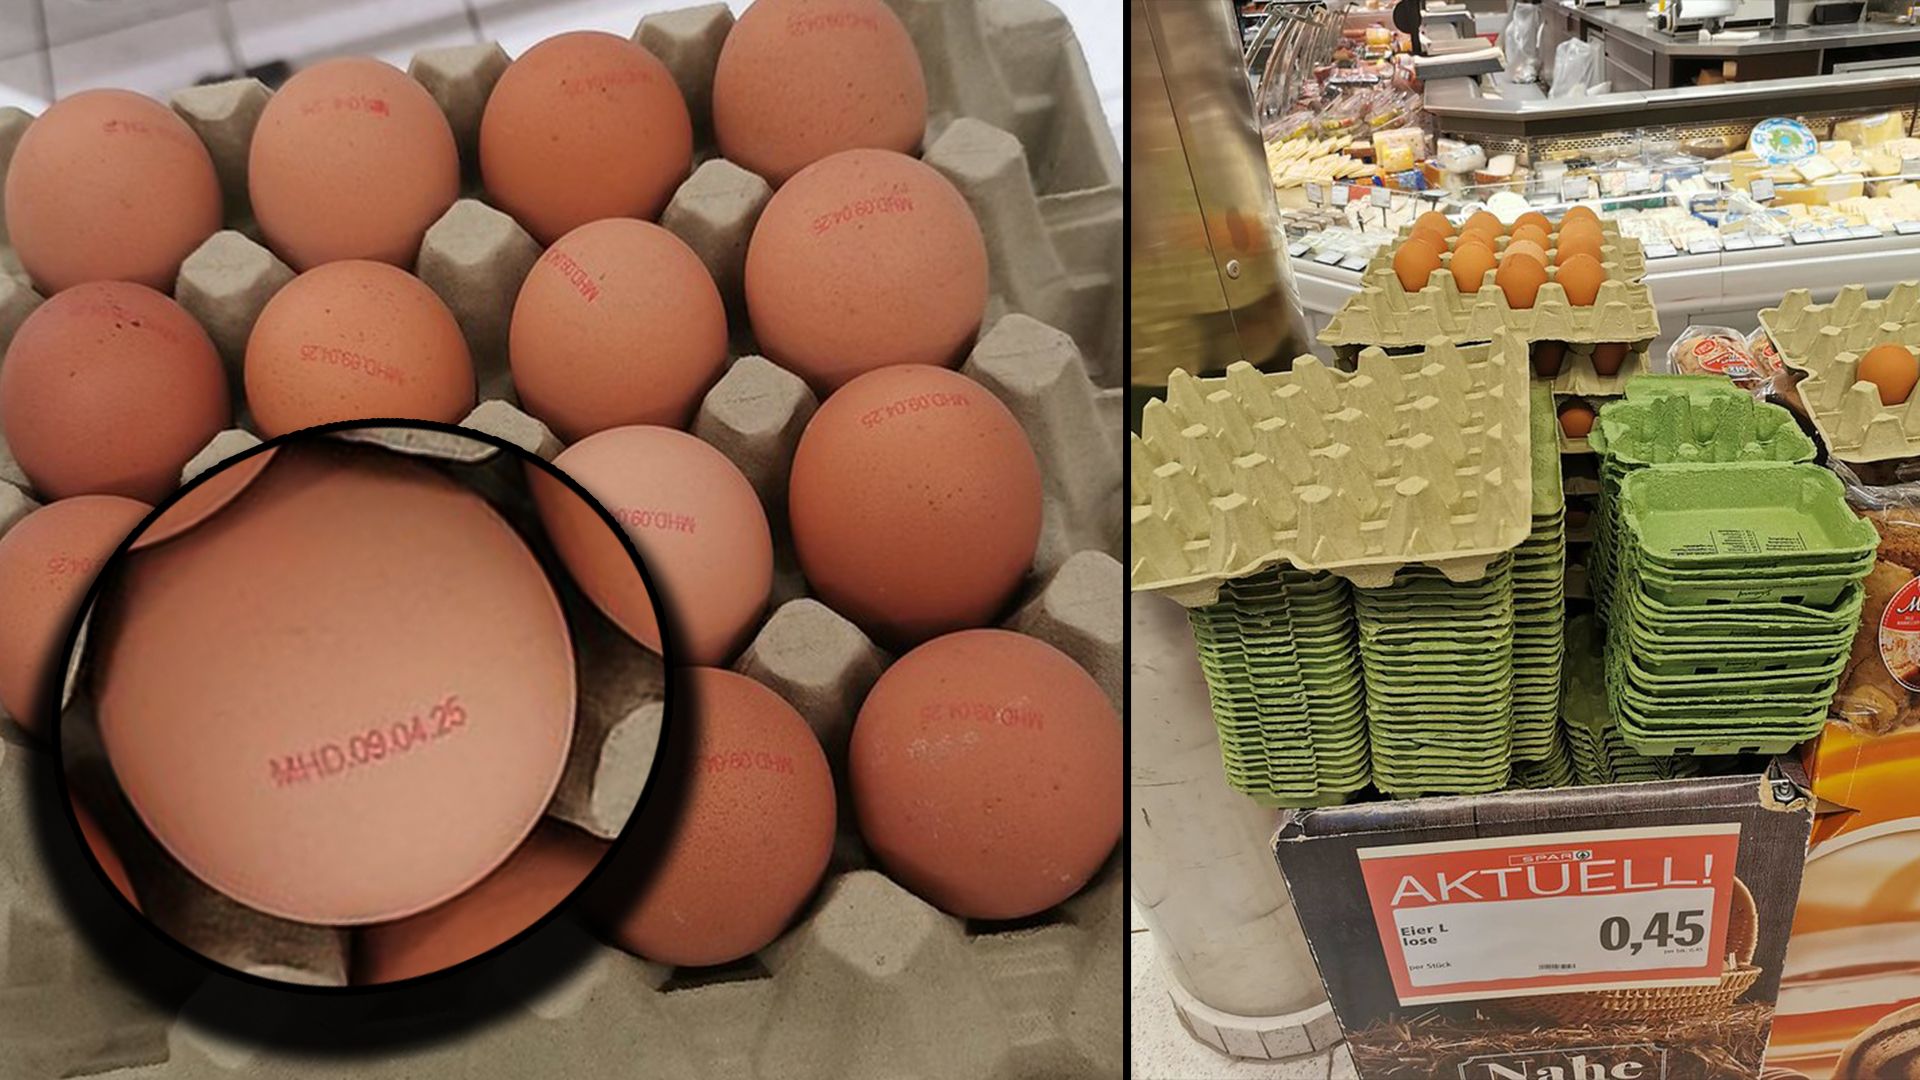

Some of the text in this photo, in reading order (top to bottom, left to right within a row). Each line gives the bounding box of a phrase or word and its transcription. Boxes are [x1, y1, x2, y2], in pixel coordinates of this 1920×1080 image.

[268, 695, 467, 788] MHD.09.04.25
[1522, 853, 1573, 864] SPAR
[1390, 854, 1713, 906] AKTUELL!
[1401, 923, 1449, 937] Eier L
[1600, 909, 1705, 956] 0,45
[1403, 936, 1438, 947] lose
[1426, 961, 1452, 970] Stück
[1478, 1055, 1644, 1080] Nahe
